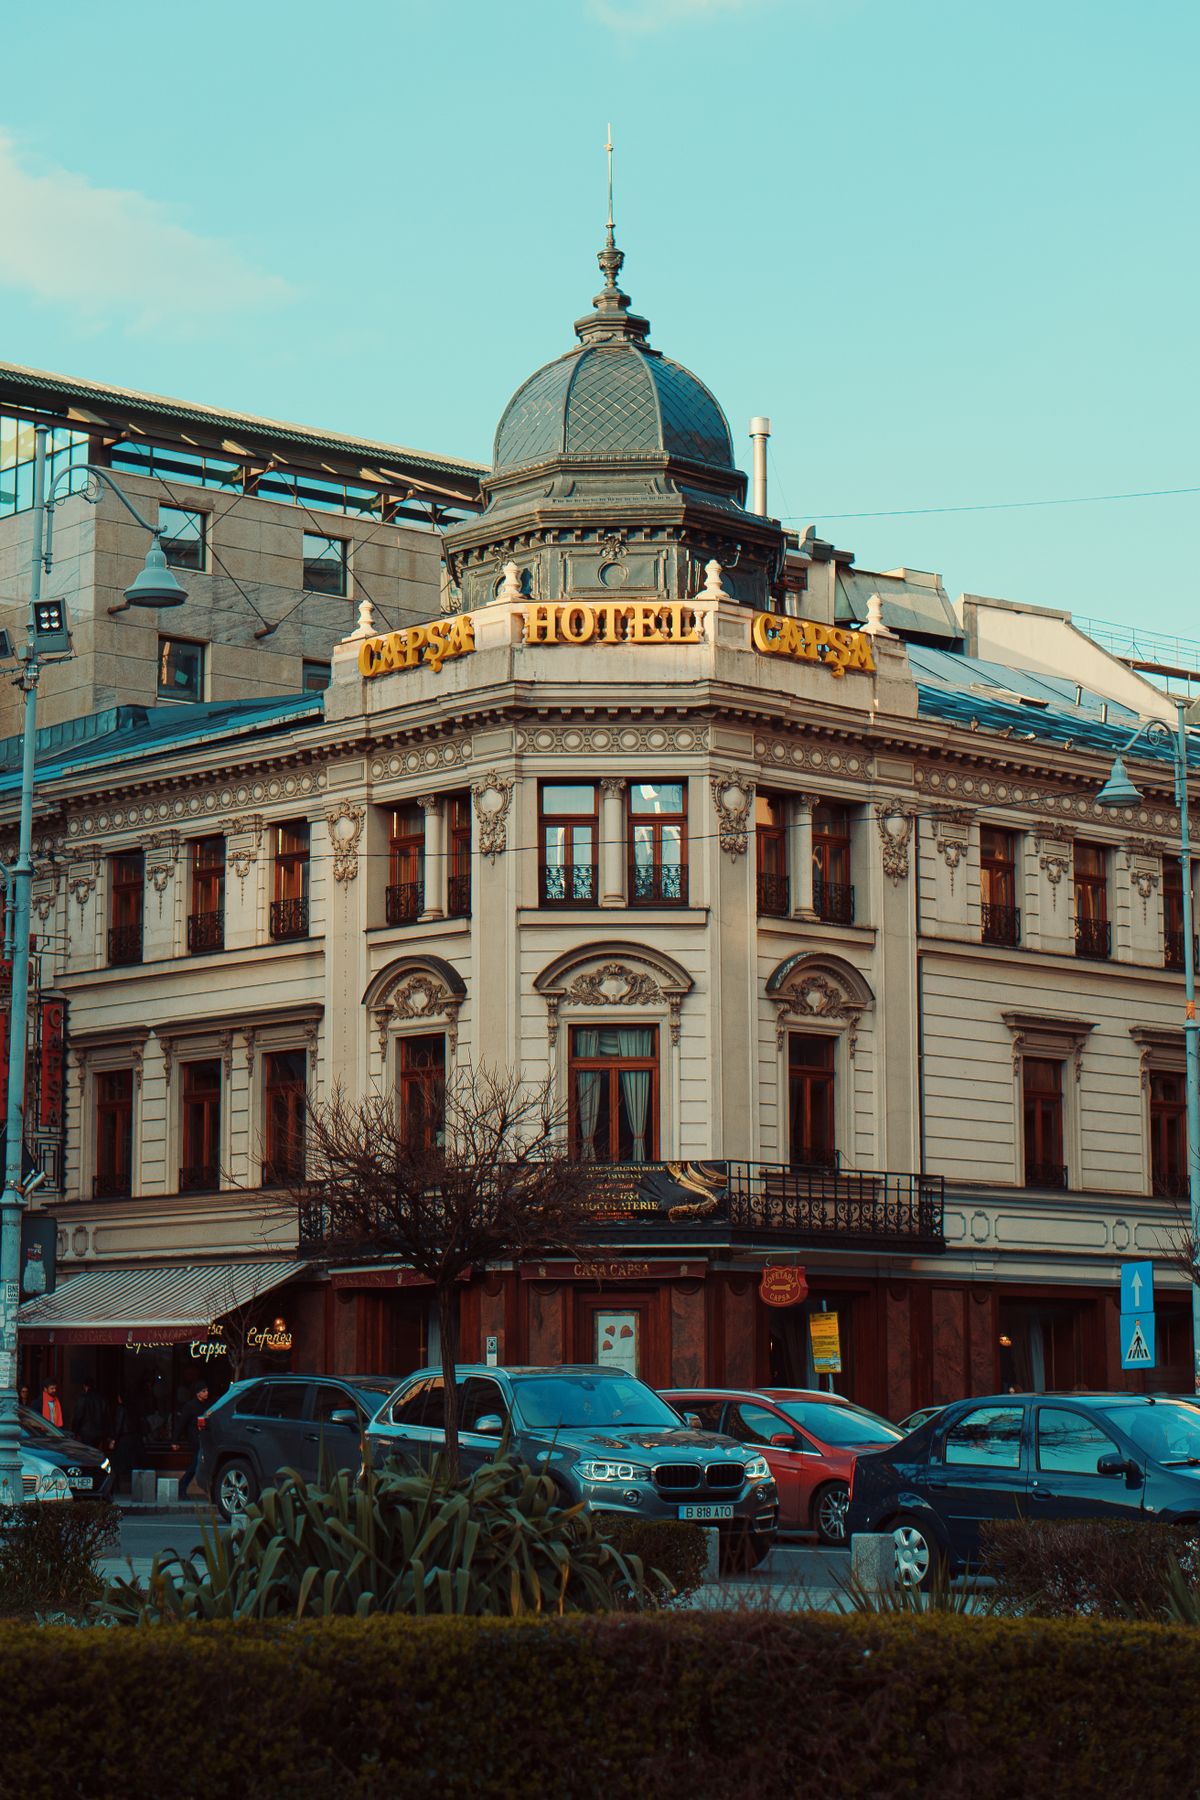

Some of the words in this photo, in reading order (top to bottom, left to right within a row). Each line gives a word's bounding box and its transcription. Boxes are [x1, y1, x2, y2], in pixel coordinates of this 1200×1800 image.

[524, 603, 703, 644] HOTEL
[574, 1264, 606, 1277] CASA
[246, 1327, 293, 1352] Cafenea
[686, 1507, 693, 1518] B
[697, 1507, 711, 1518] 818
[714, 1507, 731, 1517] ATO
